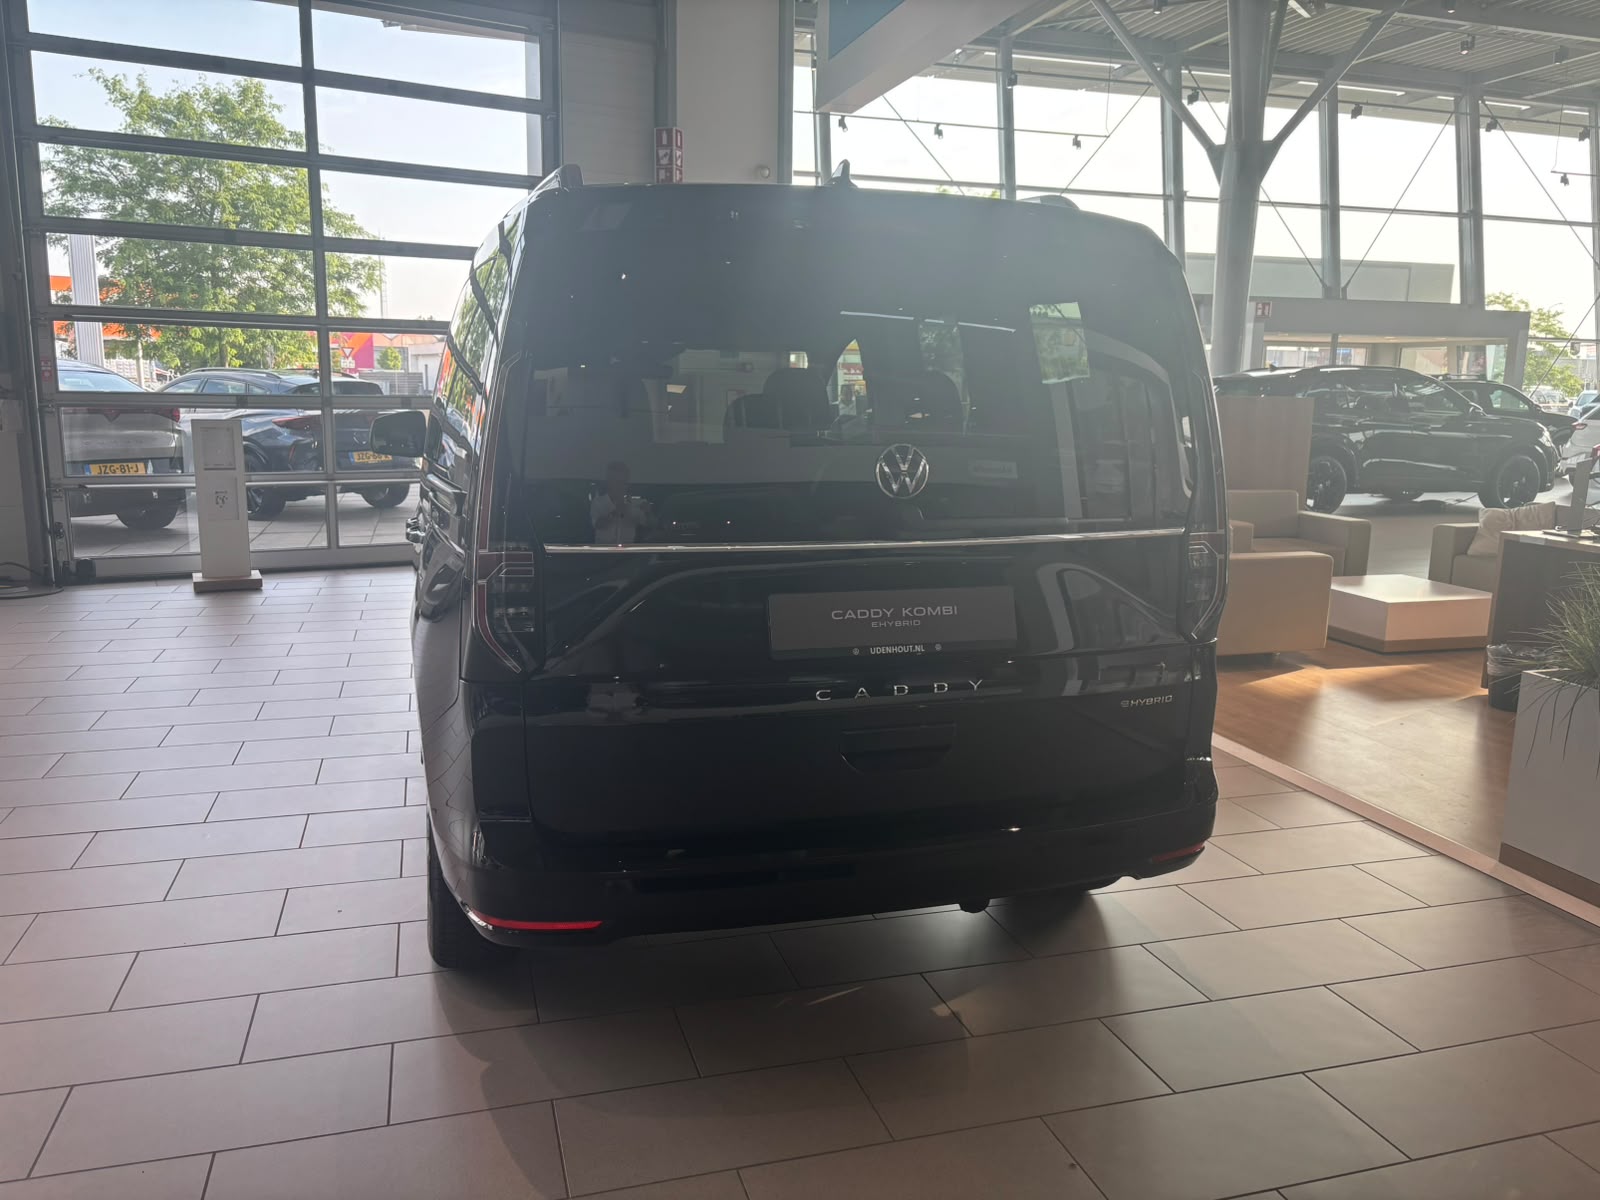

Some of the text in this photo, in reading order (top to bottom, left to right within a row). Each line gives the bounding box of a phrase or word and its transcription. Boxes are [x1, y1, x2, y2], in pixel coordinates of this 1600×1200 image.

[97, 463, 139, 475] JZG-81-J
[831, 605, 958, 620] CADDY KOMBI
[871, 619, 921, 628] EHYBRID
[870, 644, 925, 655] UDENHOUT.NL
[815, 679, 983, 701] CADDY
